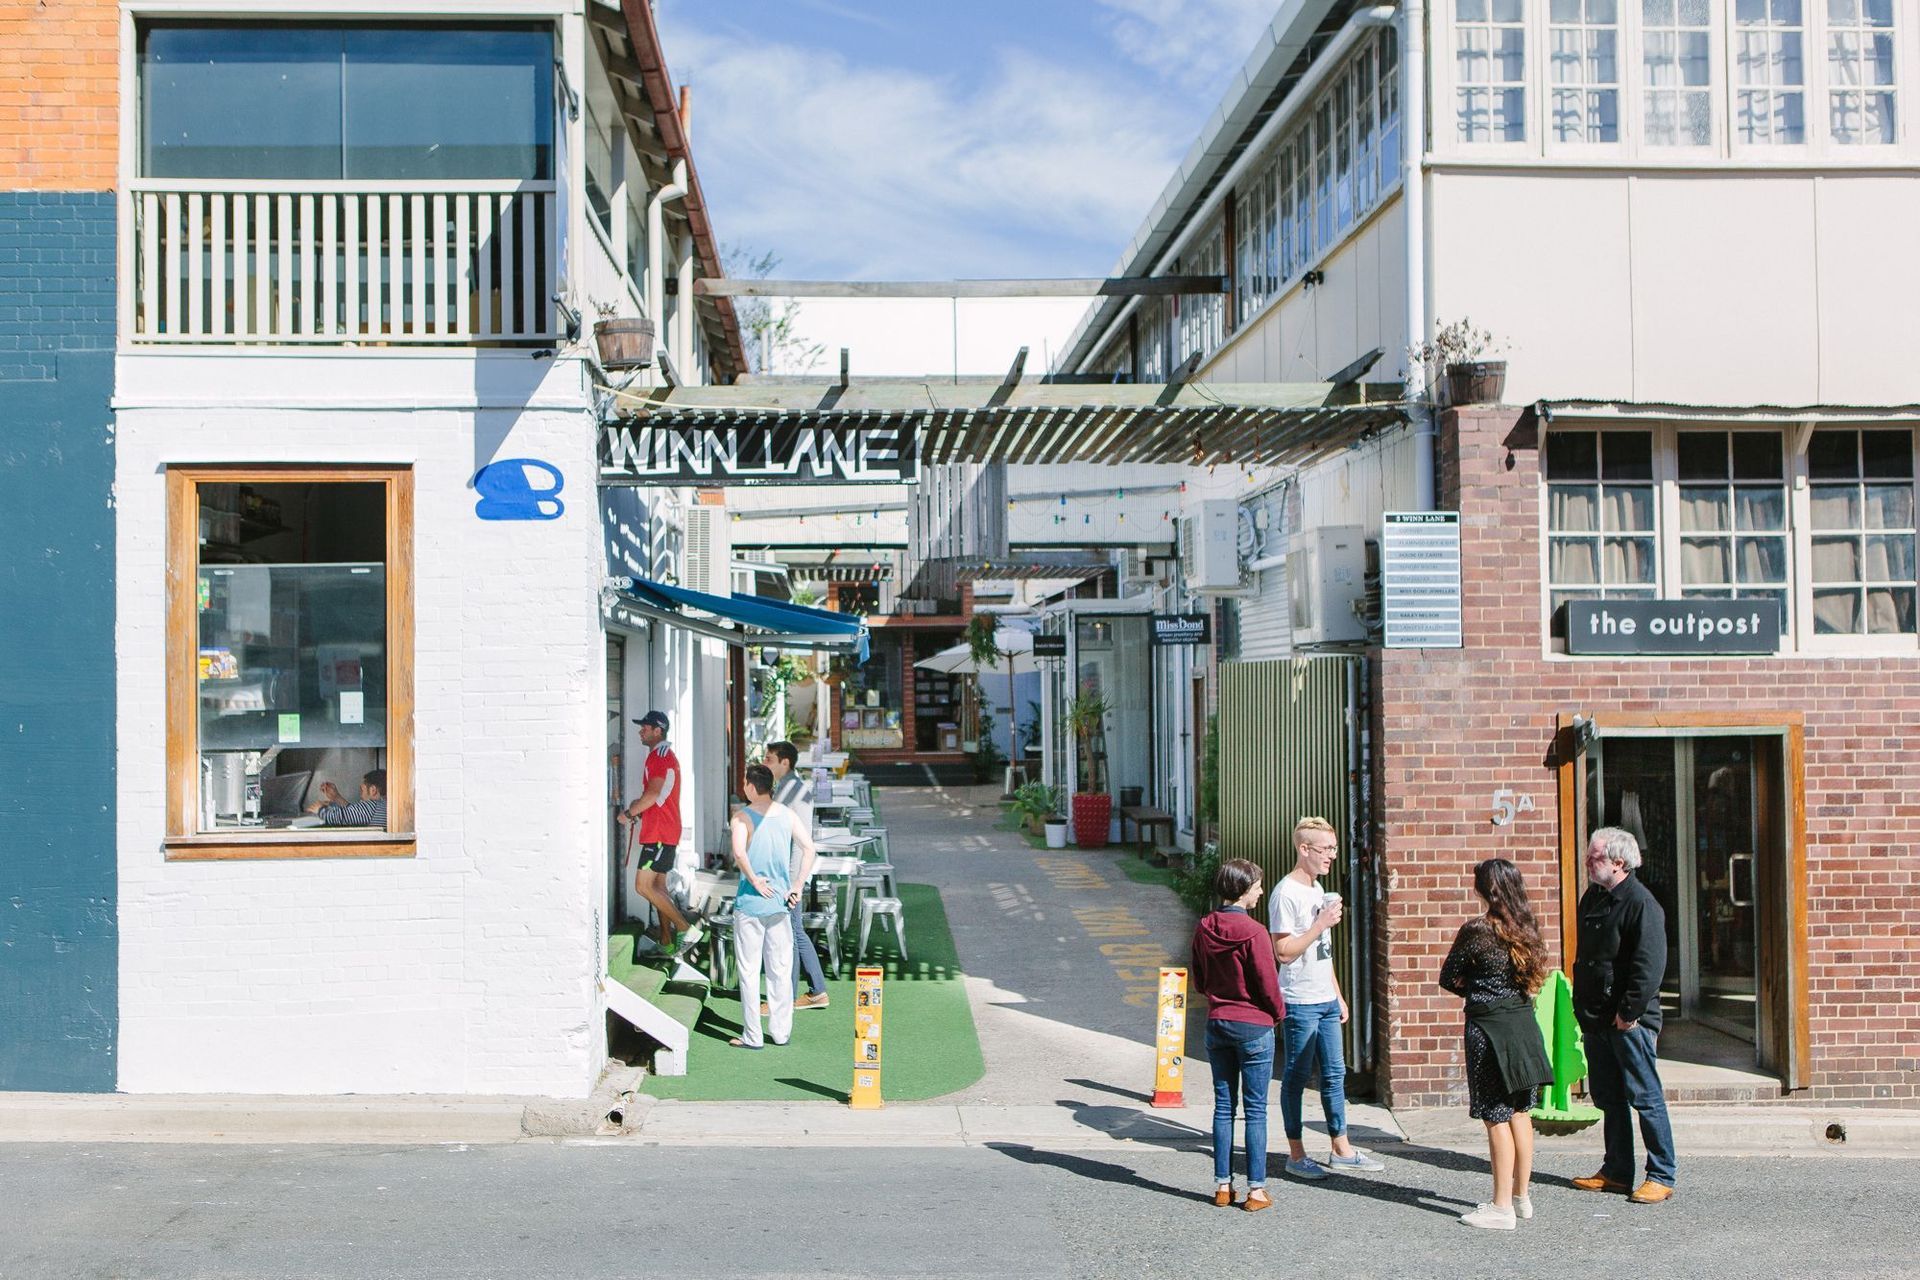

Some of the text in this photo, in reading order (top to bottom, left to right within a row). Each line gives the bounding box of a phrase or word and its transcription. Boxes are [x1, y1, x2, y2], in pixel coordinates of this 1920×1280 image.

[600, 427, 901, 481] WINN LANE
[1402, 515, 1424, 523] WINN
[1425, 515, 1446, 523] LANE
[1589, 610, 1761, 642] the outpost
[1491, 788, 1536, 826] 5A
